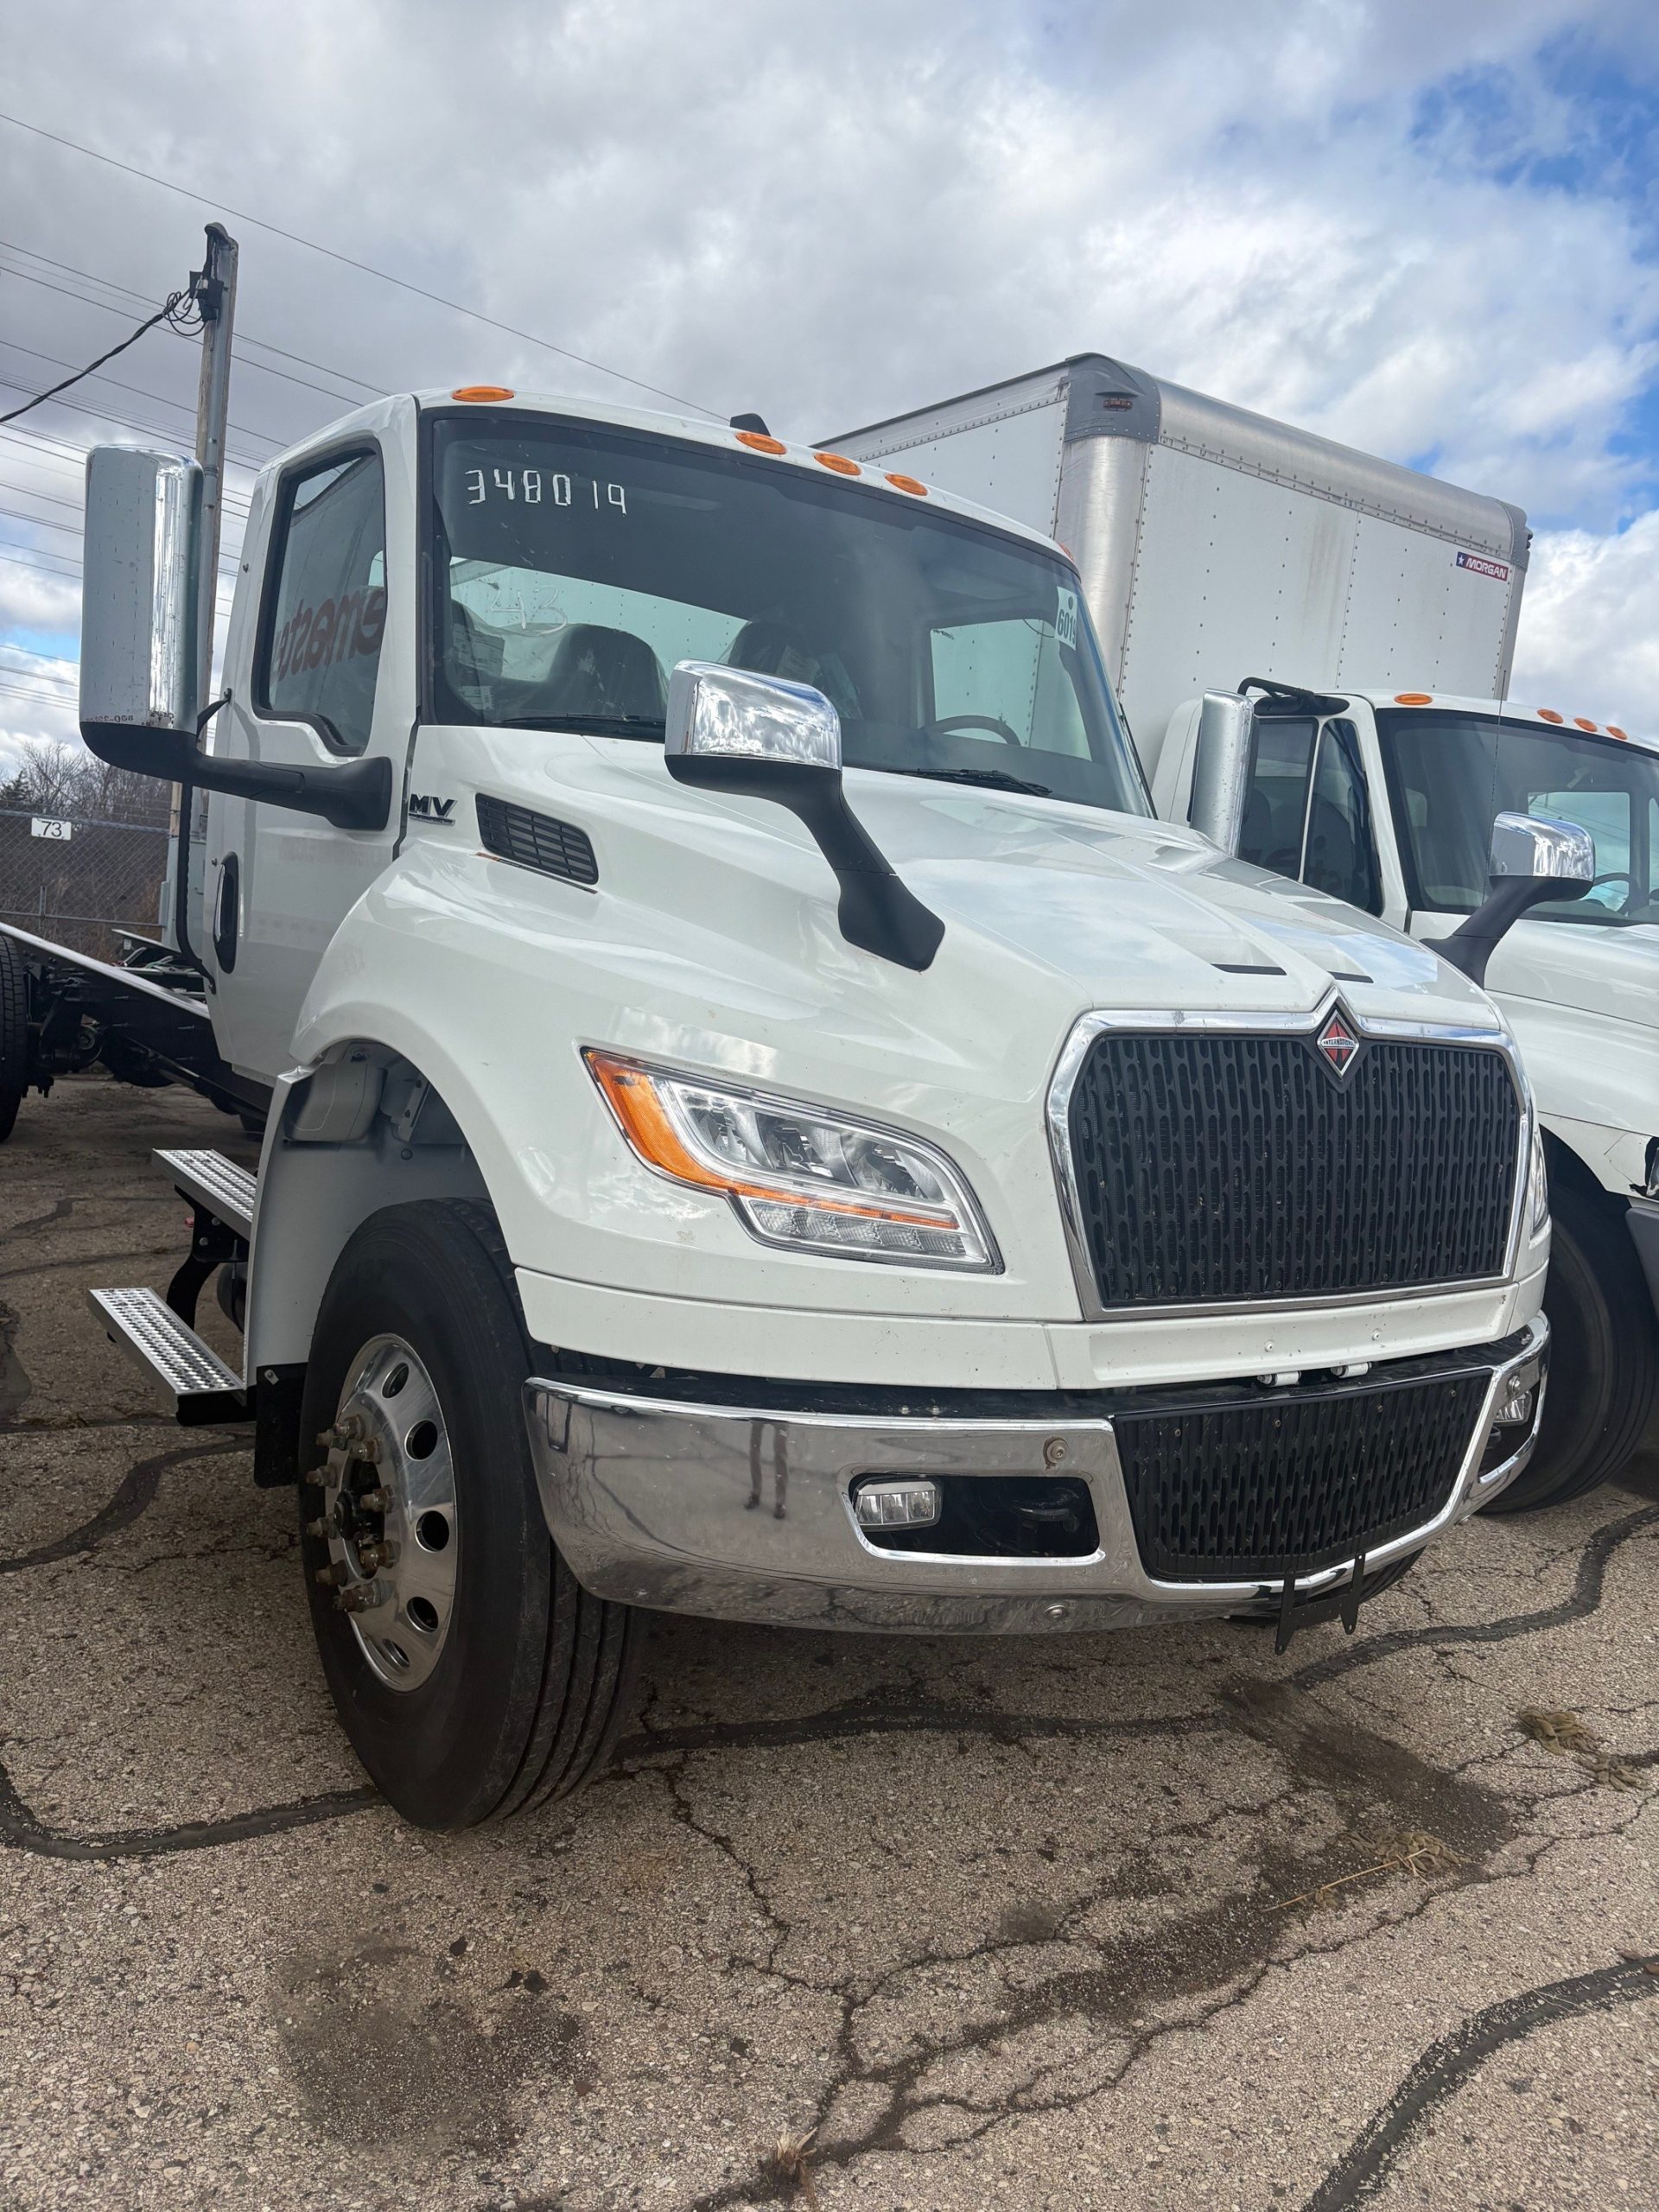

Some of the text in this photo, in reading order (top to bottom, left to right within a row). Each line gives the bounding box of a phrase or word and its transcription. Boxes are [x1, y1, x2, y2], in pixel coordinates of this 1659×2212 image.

[1465, 557, 1506, 579] MORGAN
[409, 793, 457, 817] MV
[41, 820, 62, 837] 73
